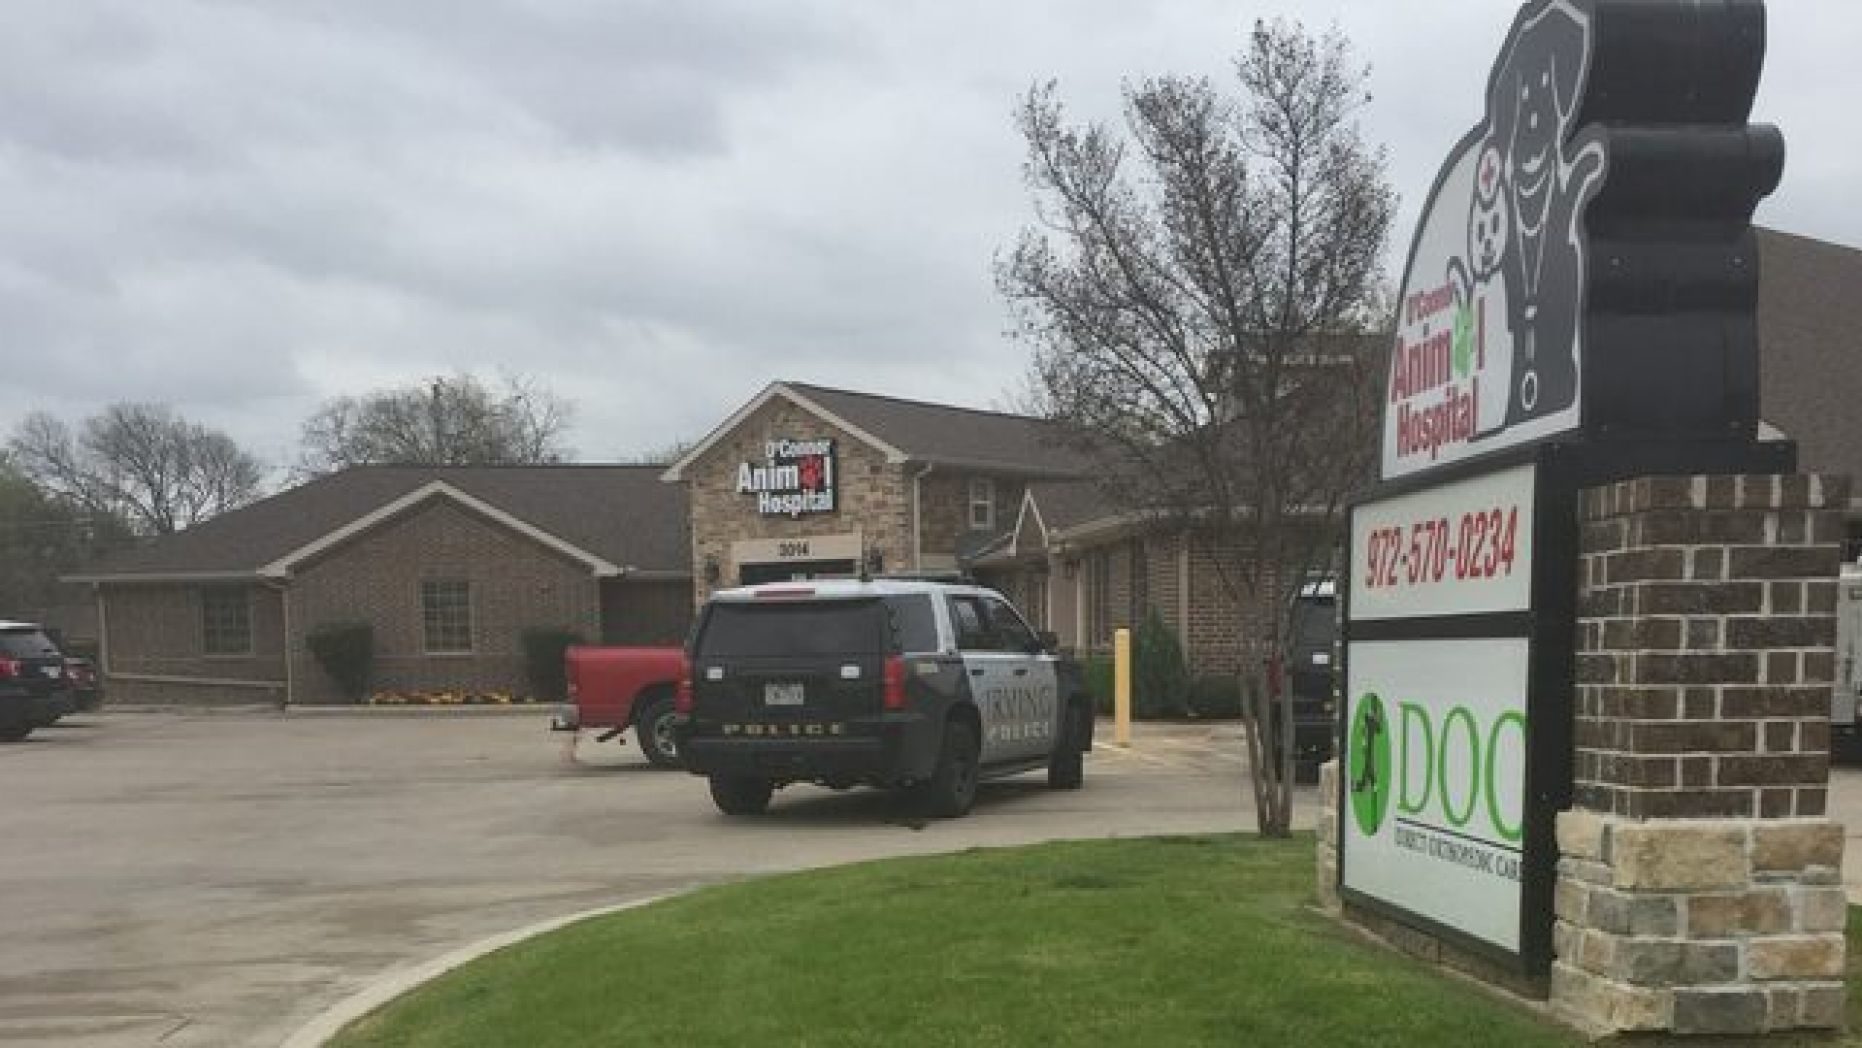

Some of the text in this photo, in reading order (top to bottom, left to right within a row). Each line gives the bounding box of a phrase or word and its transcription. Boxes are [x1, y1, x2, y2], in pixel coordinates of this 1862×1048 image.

[1397, 375, 1479, 462] Hospital
[759, 489, 833, 519] Hospital
[1365, 504, 1518, 589] 972-570-0234
[723, 722, 843, 736] POLICE
[984, 720, 1050, 741] POLICE
